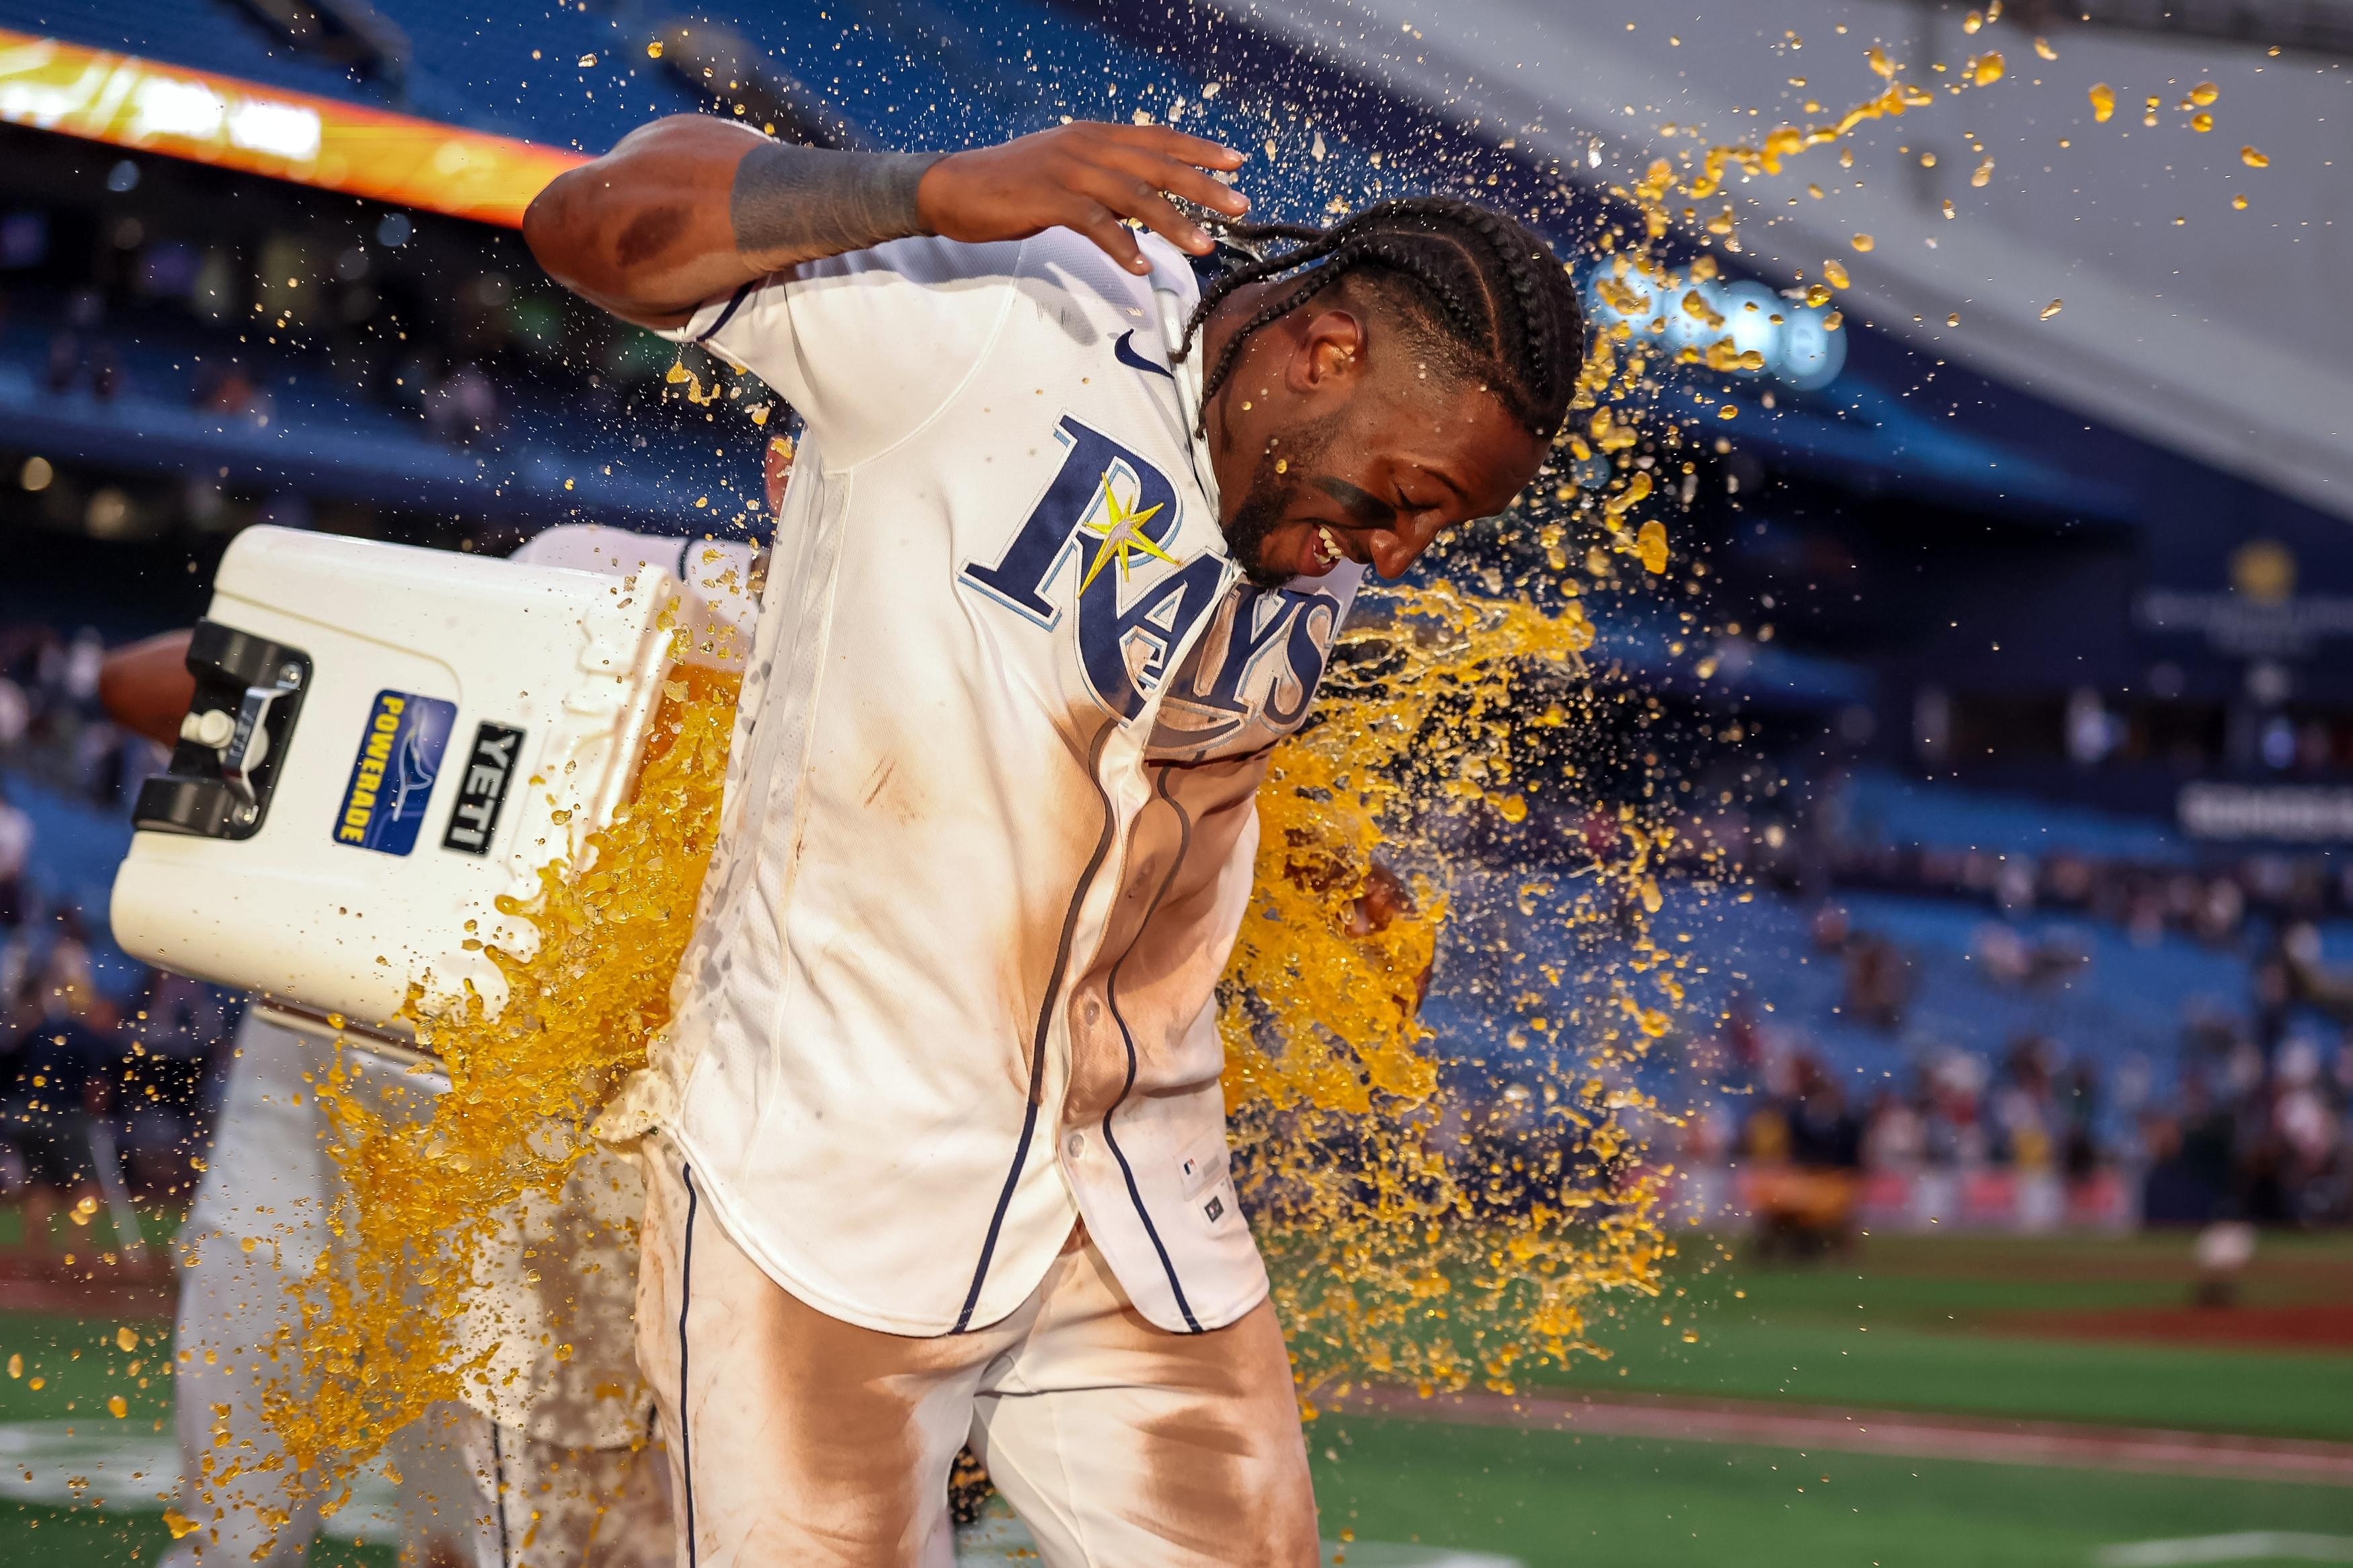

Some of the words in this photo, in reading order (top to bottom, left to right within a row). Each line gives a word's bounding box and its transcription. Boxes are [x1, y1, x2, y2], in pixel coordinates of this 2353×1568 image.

[957, 410, 1342, 750] RAYS
[339, 695, 405, 843] POWERADE
[450, 734, 516, 845] YETI
